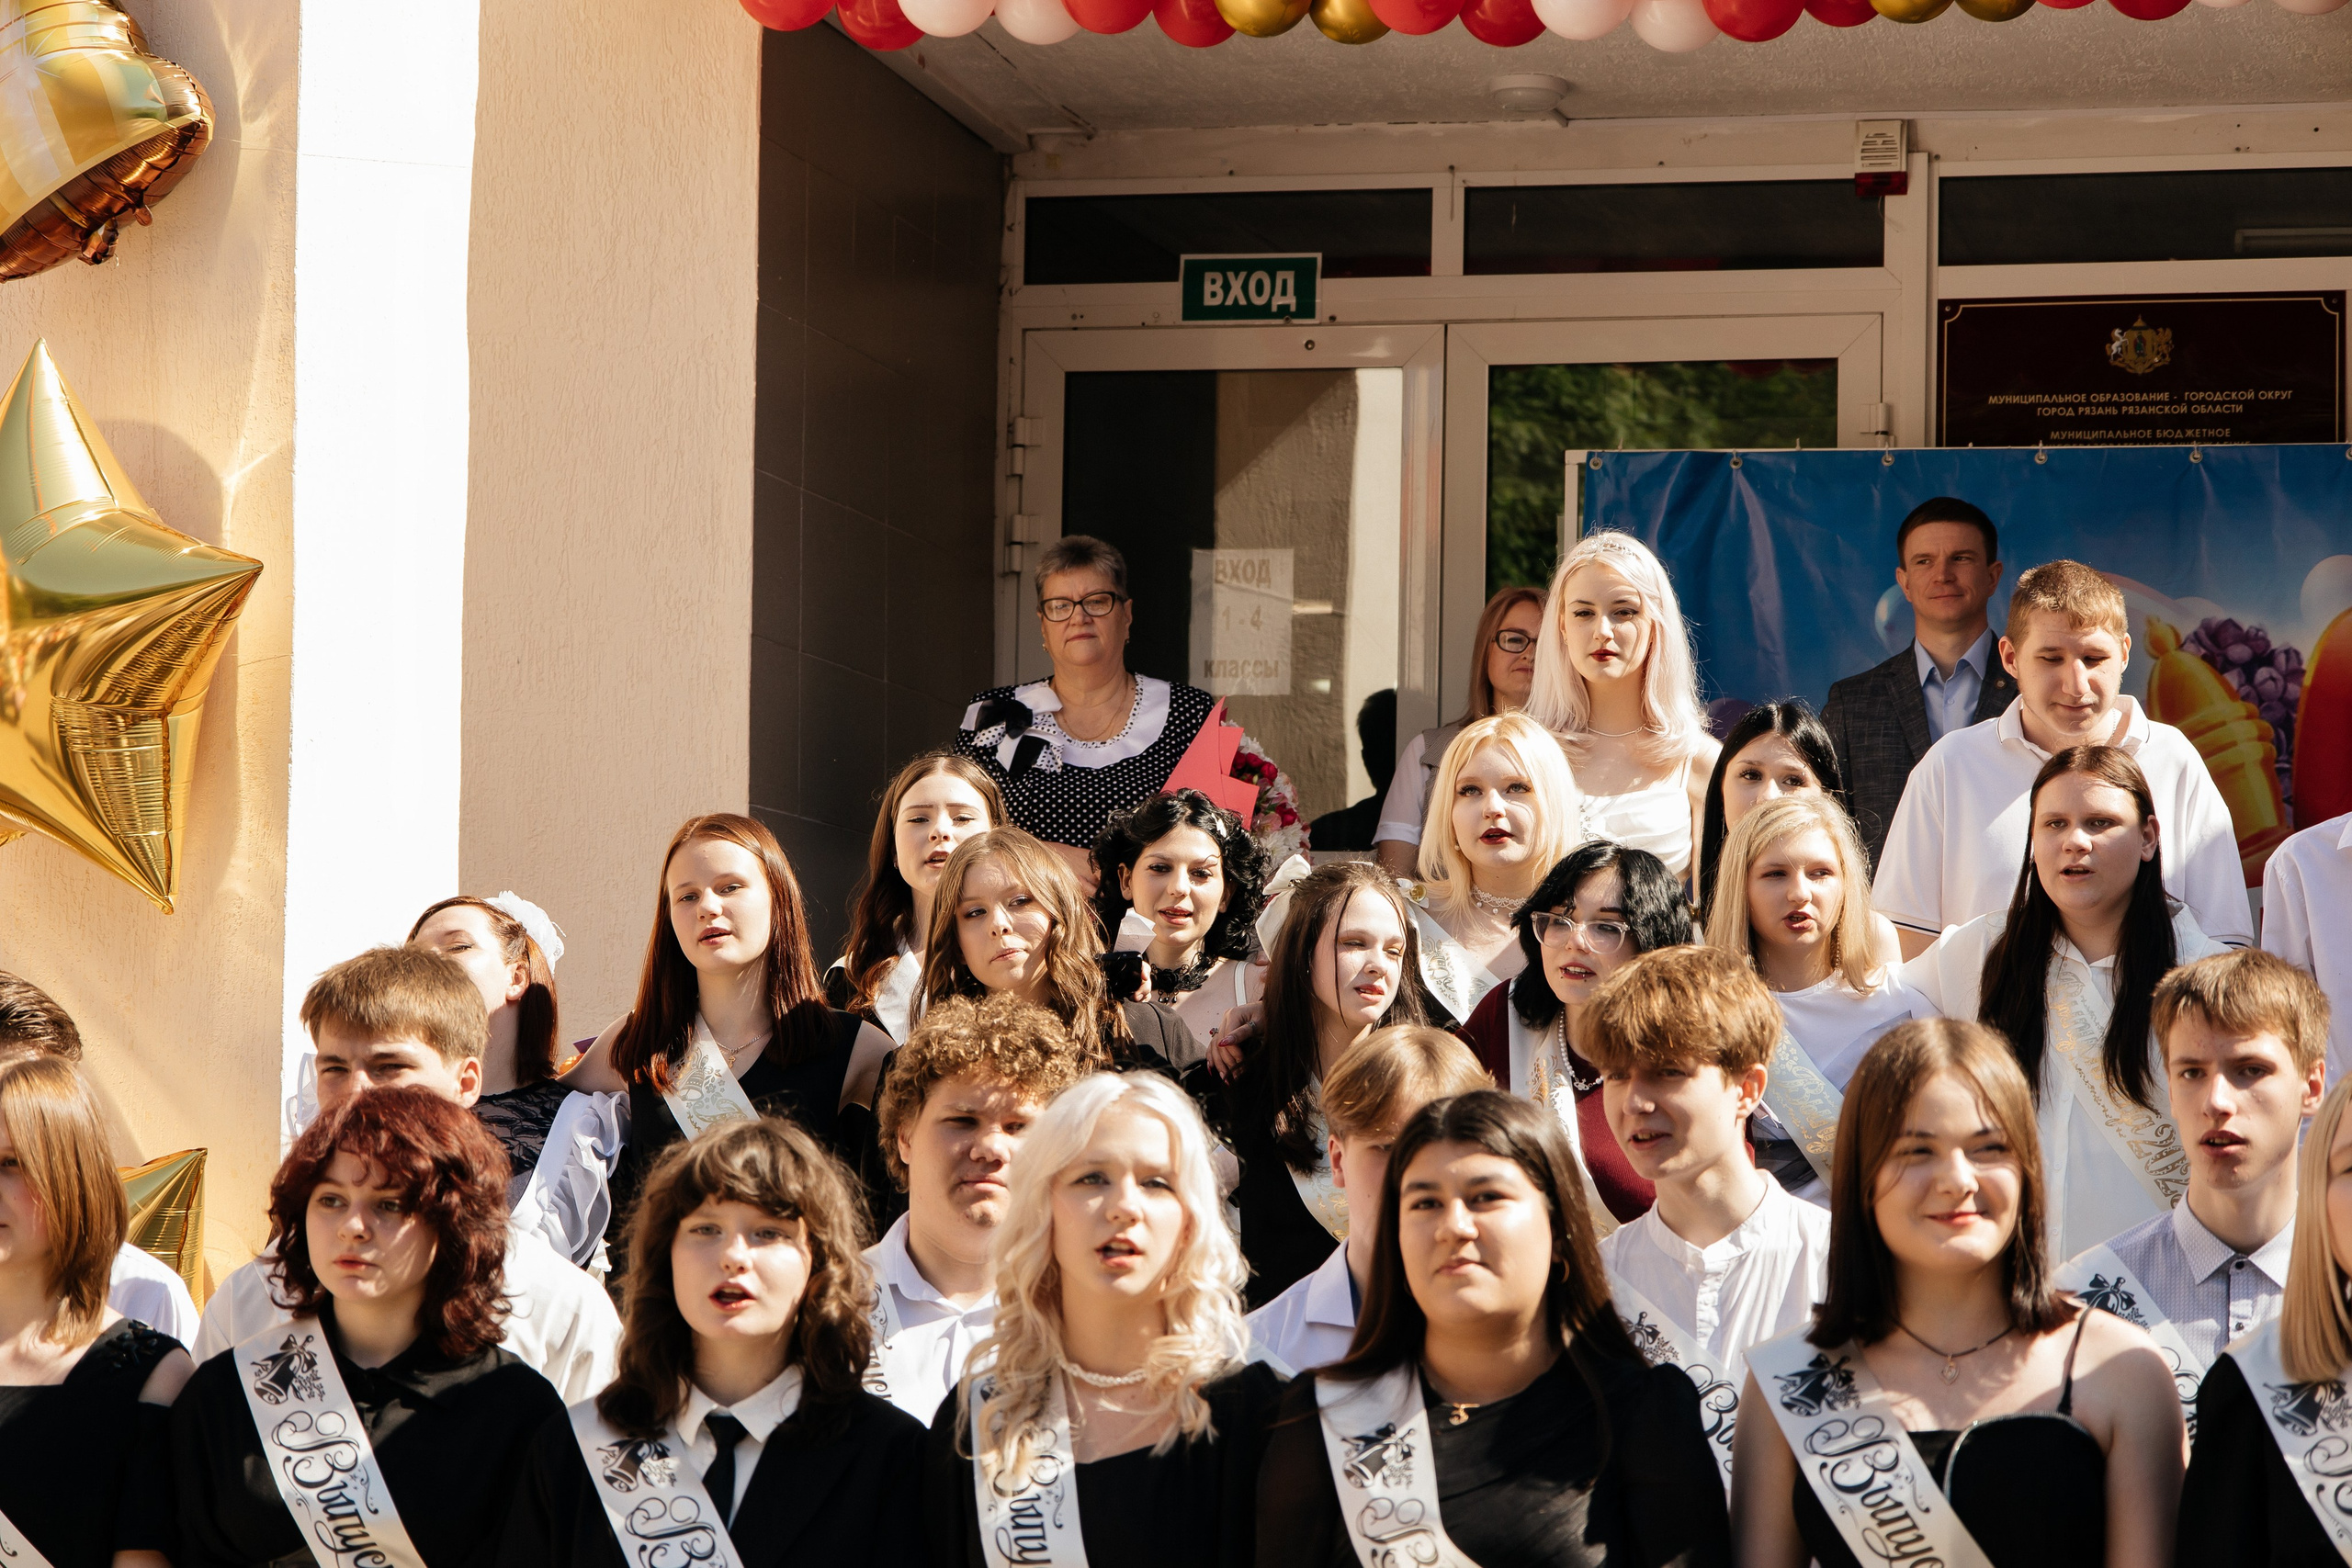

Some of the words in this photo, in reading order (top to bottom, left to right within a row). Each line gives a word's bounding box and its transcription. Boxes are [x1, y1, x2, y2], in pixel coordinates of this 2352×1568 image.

[1203, 270, 1296, 312] ВХОД
[1987, 393, 2087, 405] МУНИЦИПАЛЬНОЕ
[2089, 391, 2170, 403] ОБРАЗОВАНИЕ
[2184, 389, 2256, 401] ГОРОДСКОЙ
[2257, 389, 2293, 401] ОКРУГ
[2037, 406, 2075, 417] ГОРОД
[2077, 406, 2119, 416] РЯЗАНЬ
[2120, 402, 2188, 416] РЯЗАНСКОЙ
[2190, 403, 2244, 414] ОБЛАСТИ
[2050, 429, 2153, 441] МУНИЦИПАЛЬНОЕ
[2155, 428, 2232, 439] БЮДЖЕТНОЕ
[1215, 558, 1272, 589] ВХОД
[1204, 659, 1279, 679] классы
[2126, 1122, 2191, 1210] 202
[271, 1410, 395, 1568] Выпус
